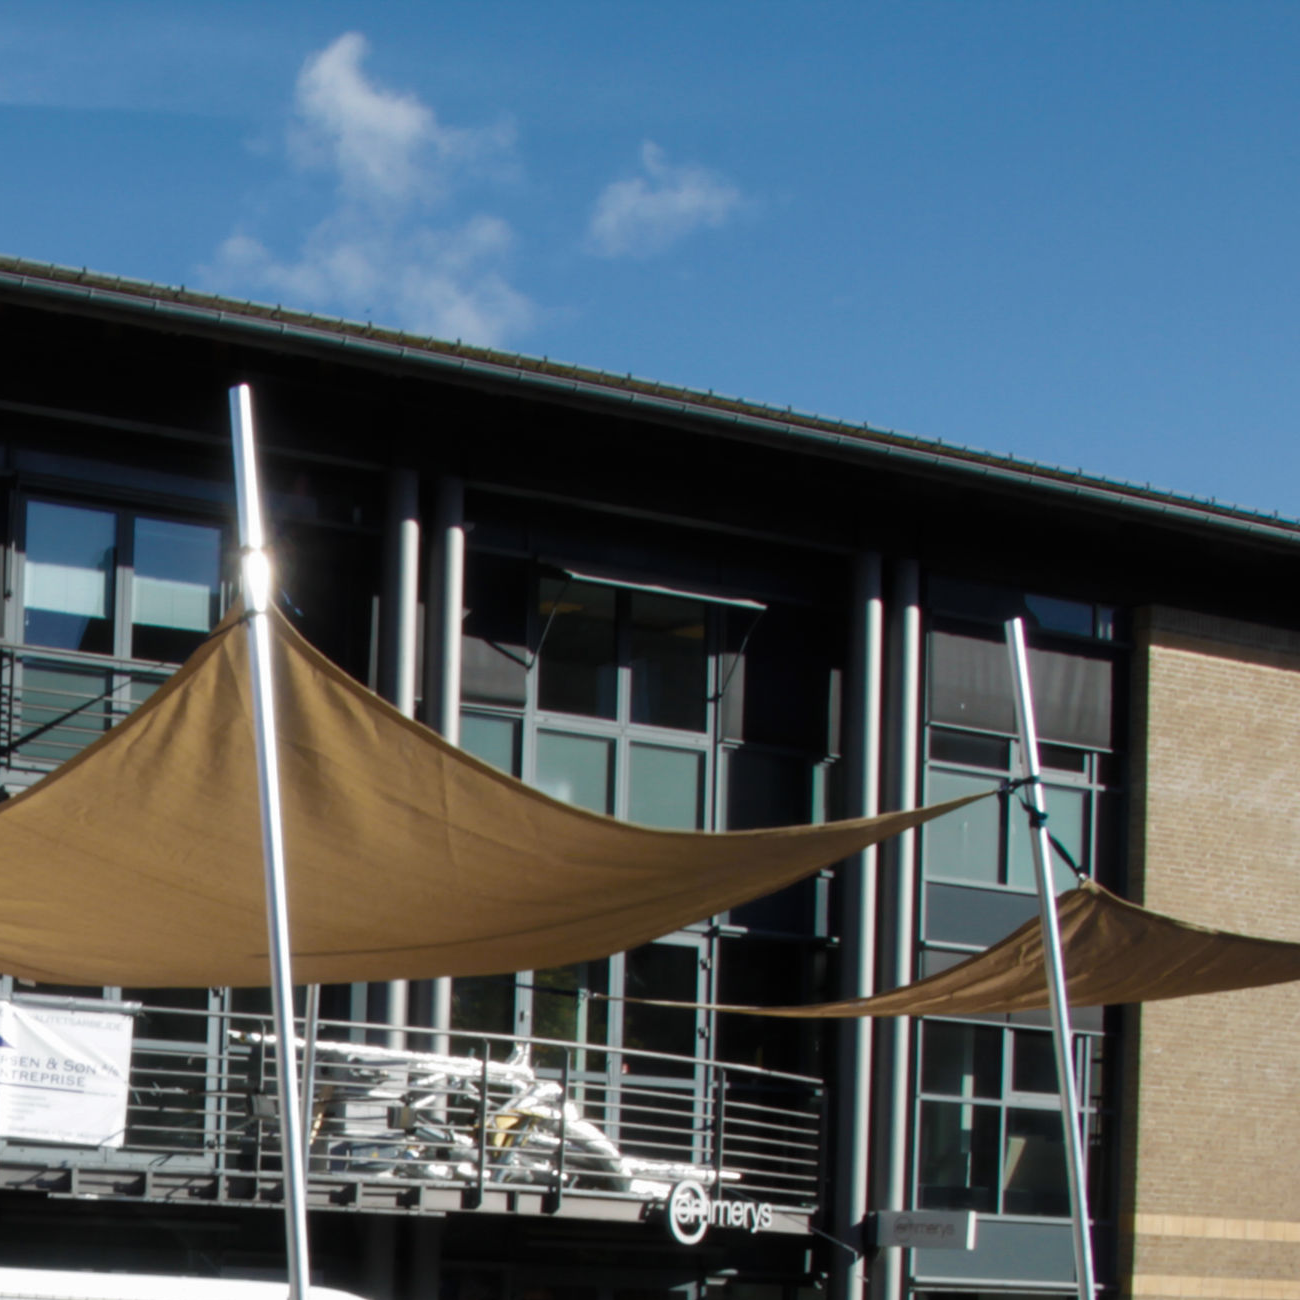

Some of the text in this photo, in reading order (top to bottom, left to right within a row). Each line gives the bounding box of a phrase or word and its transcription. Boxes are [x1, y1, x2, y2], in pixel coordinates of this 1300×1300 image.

[45, 1058, 58, 1070] &
[63, 1060, 97, 1075] SØN
[674, 1198, 773, 1233] emmerys
